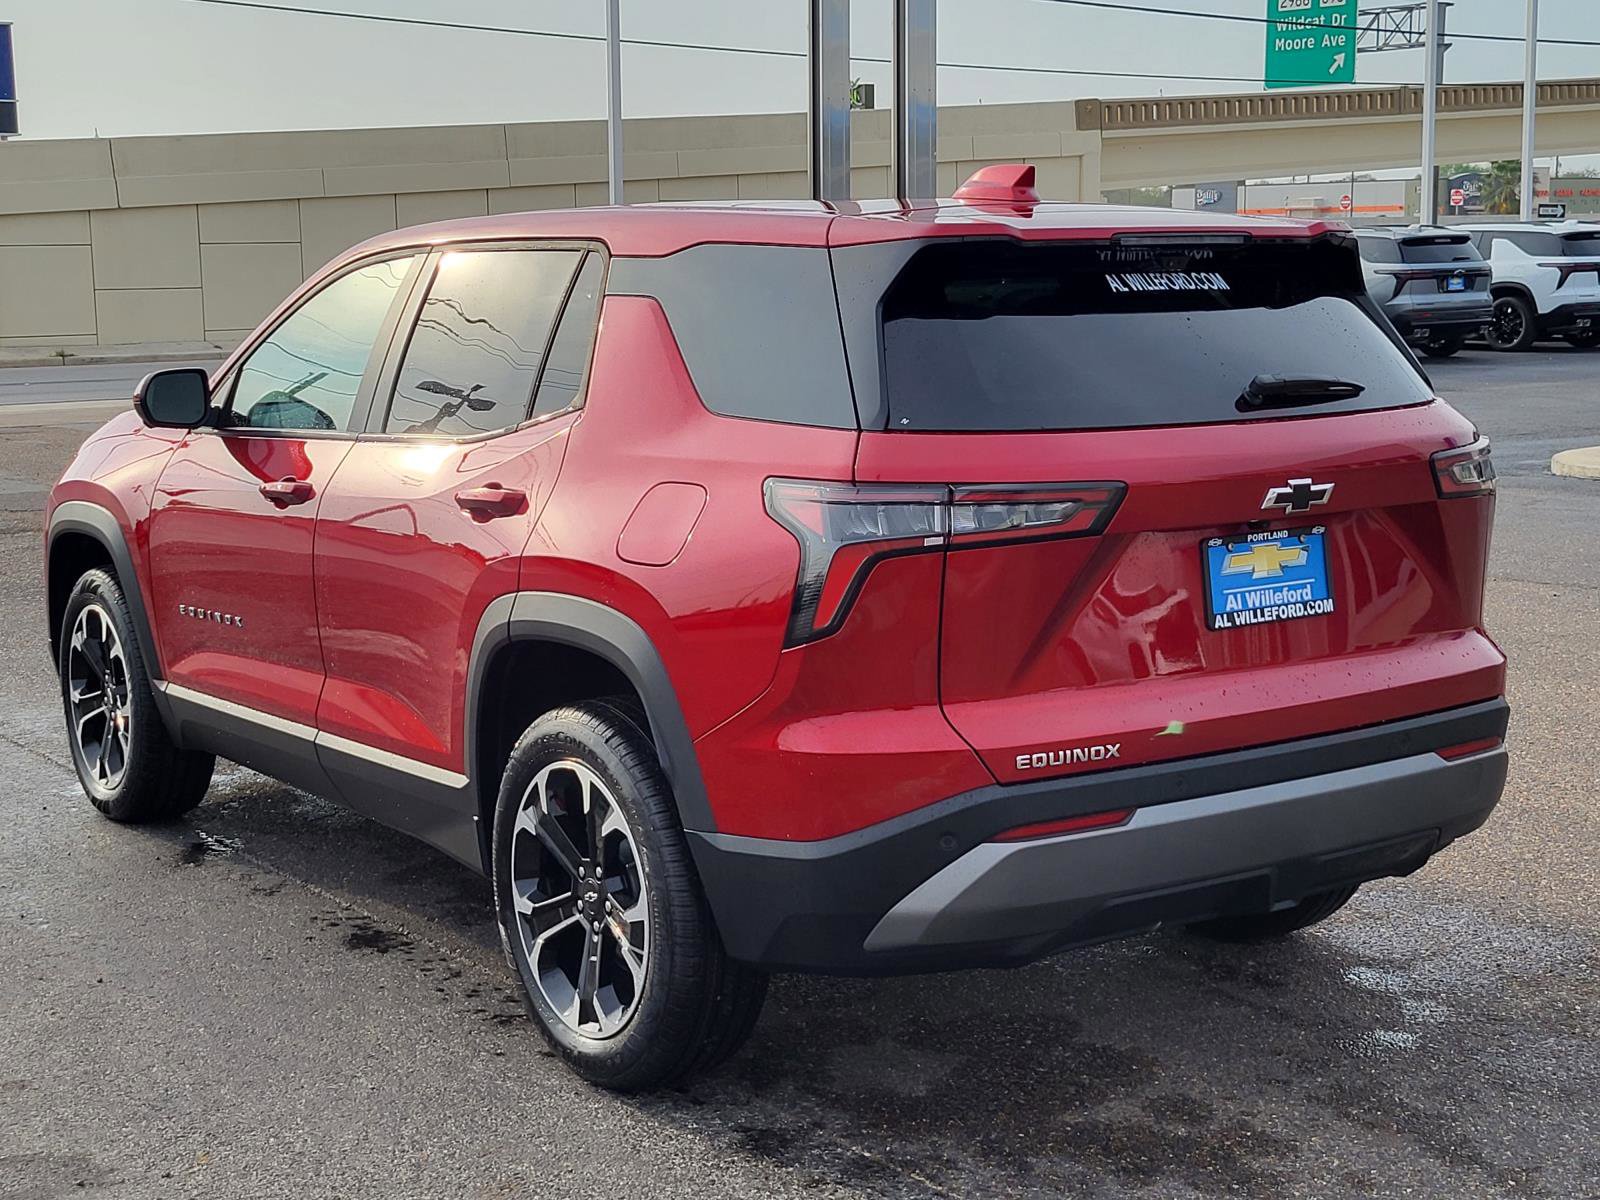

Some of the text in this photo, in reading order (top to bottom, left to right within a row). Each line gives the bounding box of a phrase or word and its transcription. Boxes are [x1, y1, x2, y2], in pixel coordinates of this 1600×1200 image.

[1276, 13, 1347, 32] Wildcat Dr
[1275, 34, 1346, 51] Moore Ave
[1247, 530, 1288, 542] PORTLAND
[1225, 584, 1312, 611] Al Willeford
[179, 604, 244, 628] EQUINOX
[1215, 599, 1334, 629] AL WILLEFORD.COM
[1016, 743, 1121, 769] EQUINOX
